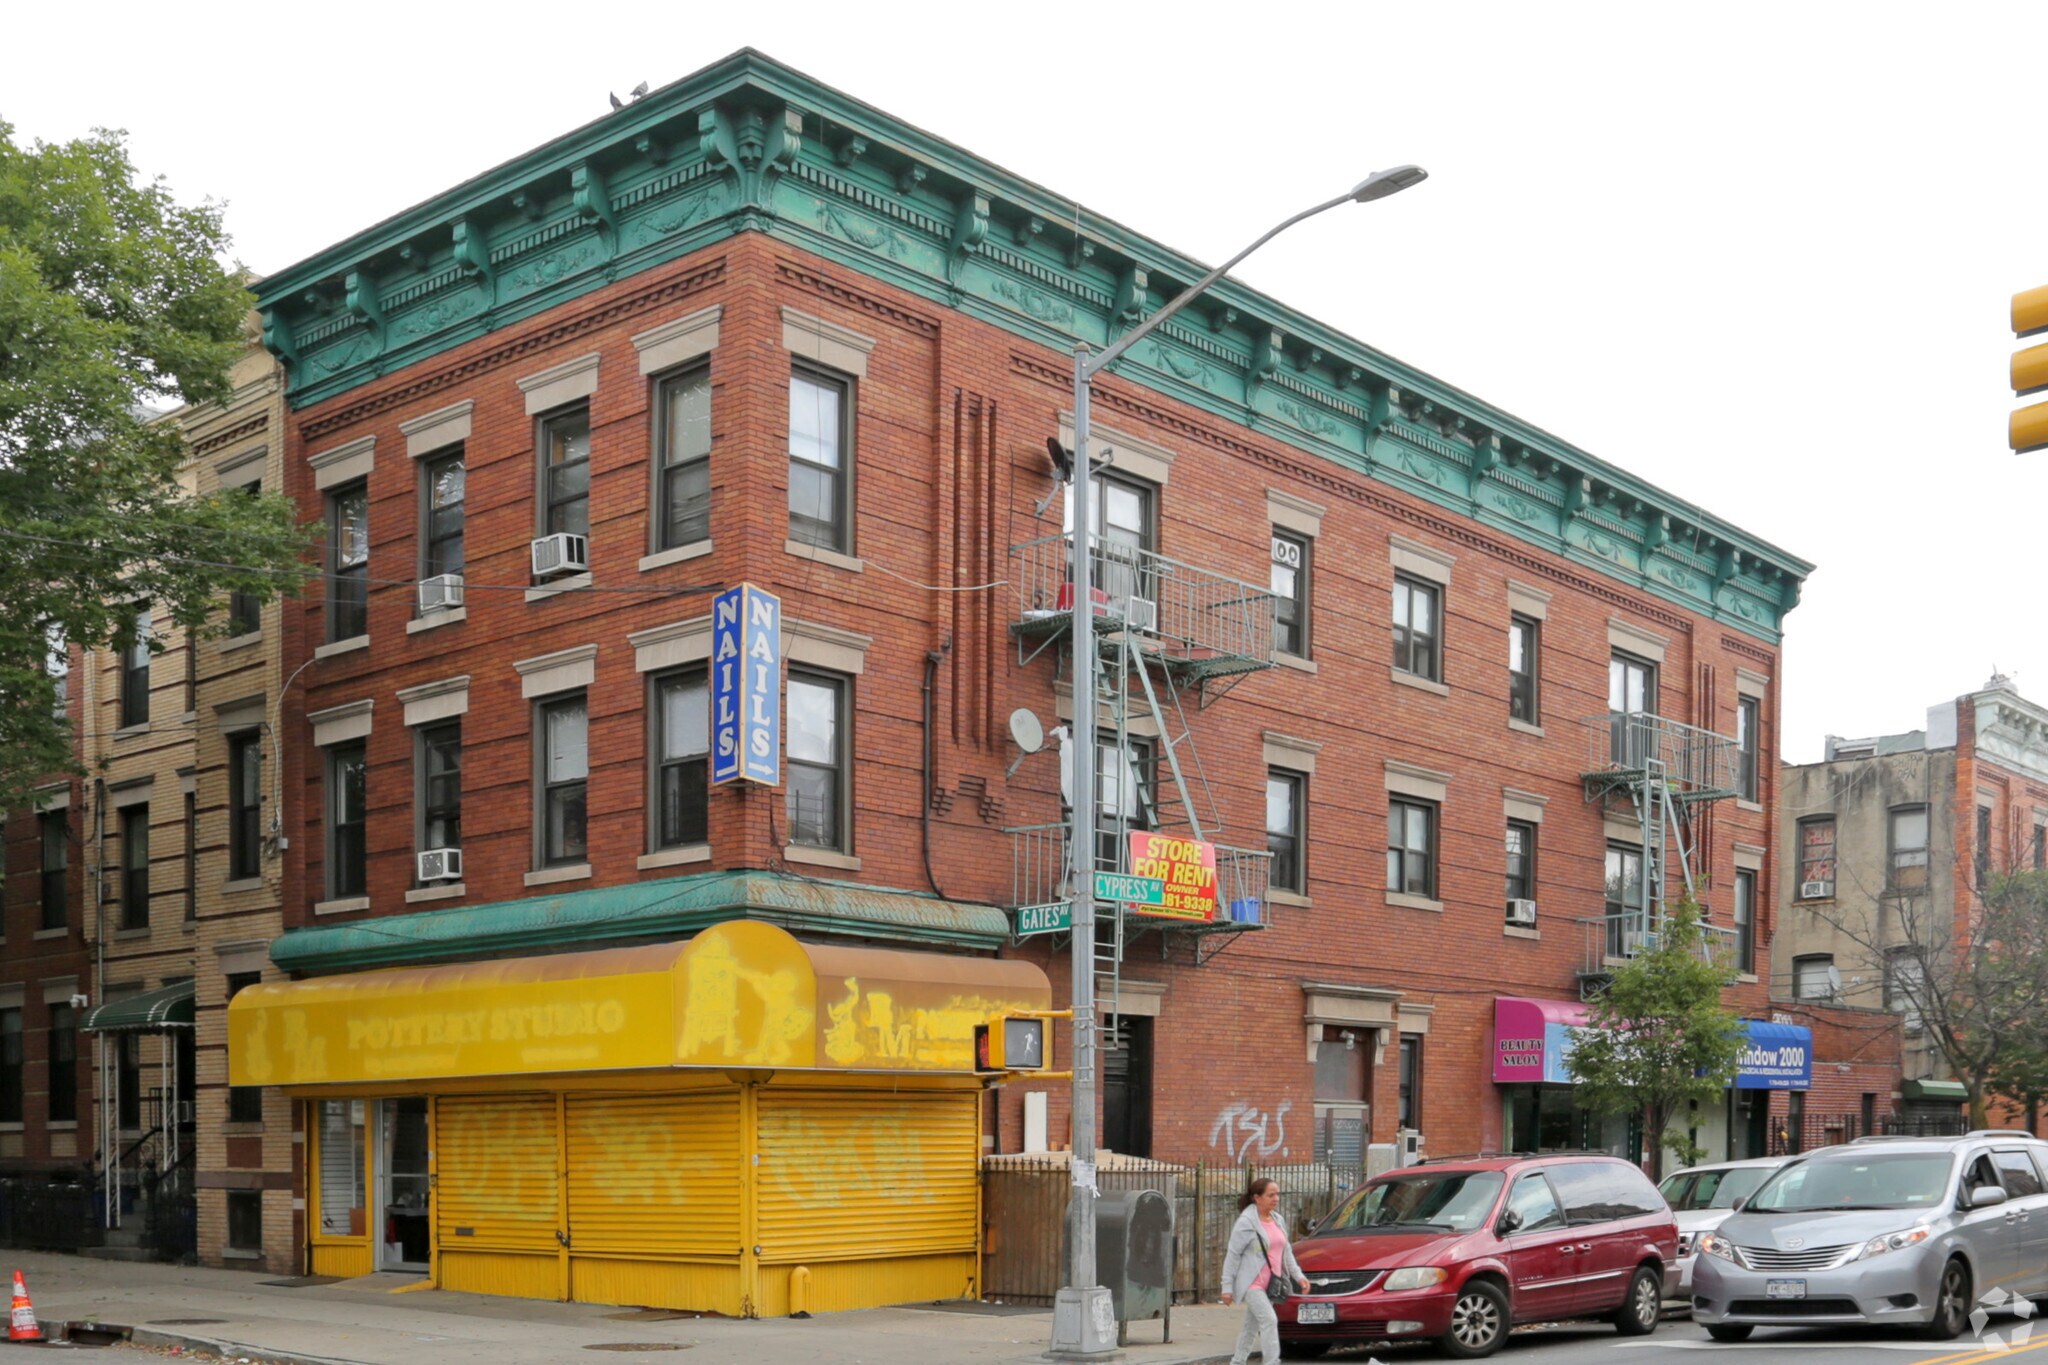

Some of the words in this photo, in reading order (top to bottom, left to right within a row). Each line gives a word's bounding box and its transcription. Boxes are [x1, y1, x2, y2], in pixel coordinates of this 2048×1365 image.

[716, 595, 739, 757] NAILS
[750, 595, 775, 758] NAILS
[1147, 837, 1203, 864] STORE
[1134, 856, 1171, 882] FOR
[1172, 861, 1215, 888] RENT
[1095, 875, 1149, 901] CYPRESS
[1150, 881, 1160, 893] AV
[1165, 883, 1200, 895] OWNER
[1022, 906, 1061, 930] GATES
[1060, 904, 1070, 917] AV
[491, 1001, 624, 1040] STUDIO
[1500, 1039, 1543, 1052] BEAUTY
[1779, 1046, 1805, 1067] 2000
[1502, 1053, 1540, 1066] SALON
